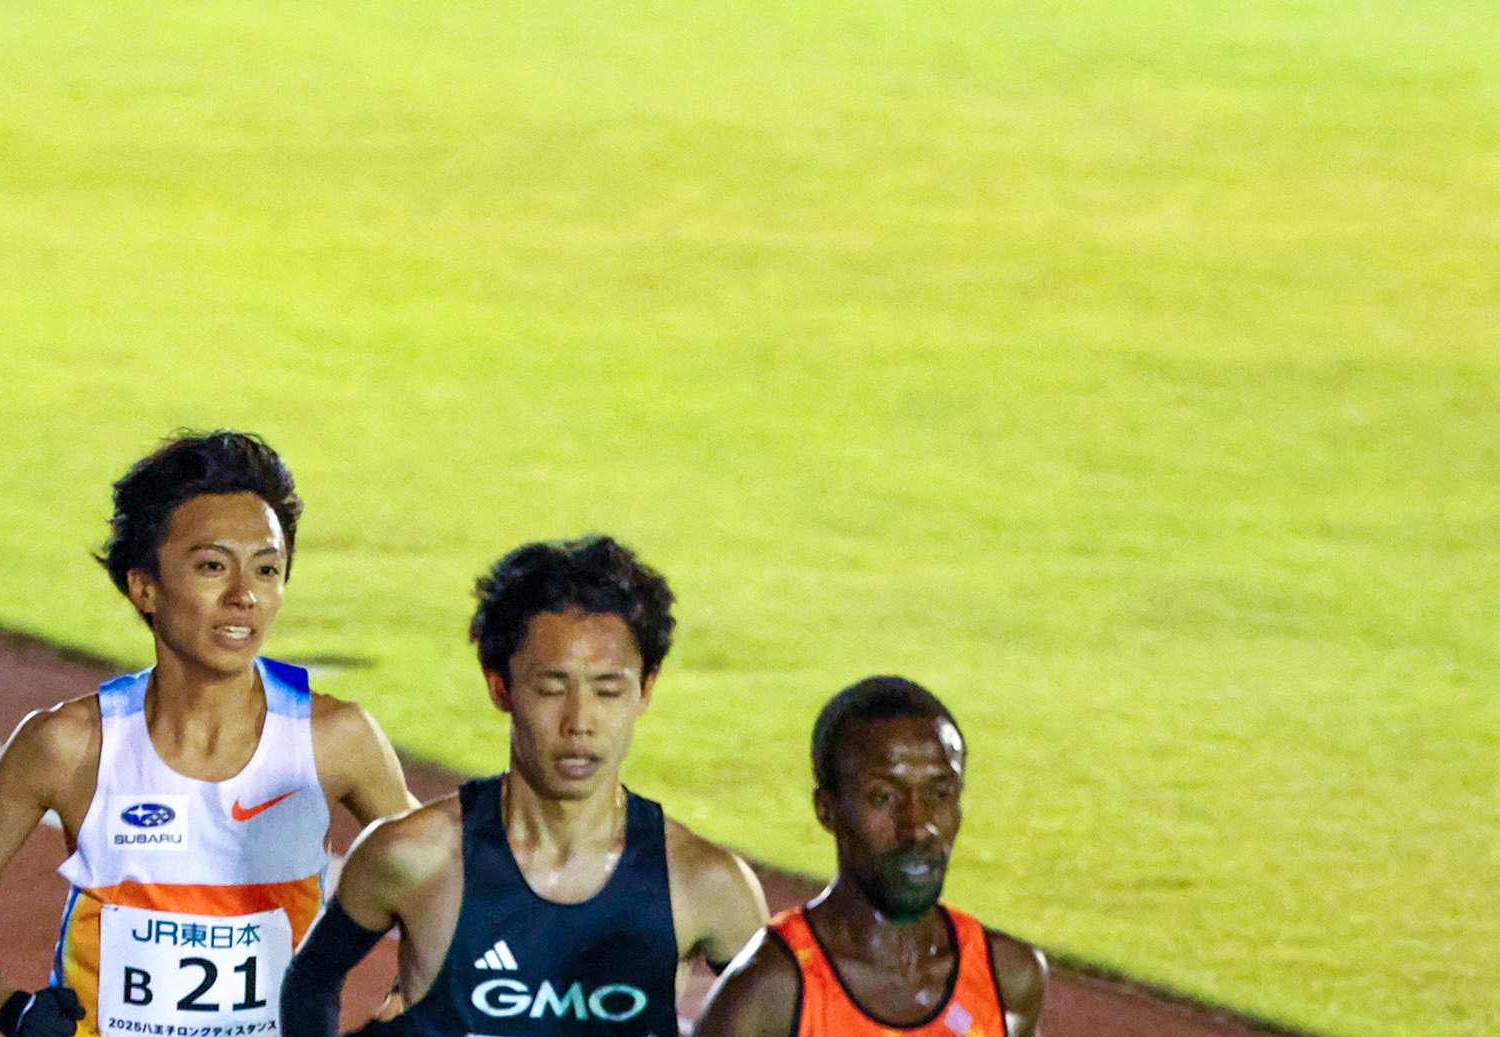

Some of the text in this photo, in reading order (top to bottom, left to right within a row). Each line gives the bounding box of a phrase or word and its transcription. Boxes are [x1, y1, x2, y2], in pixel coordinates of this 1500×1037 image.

[114, 833, 182, 846] SUBARU
[132, 918, 261, 950] JR東日本
[122, 955, 267, 1013] B 21
[471, 977, 648, 1022] GMO
